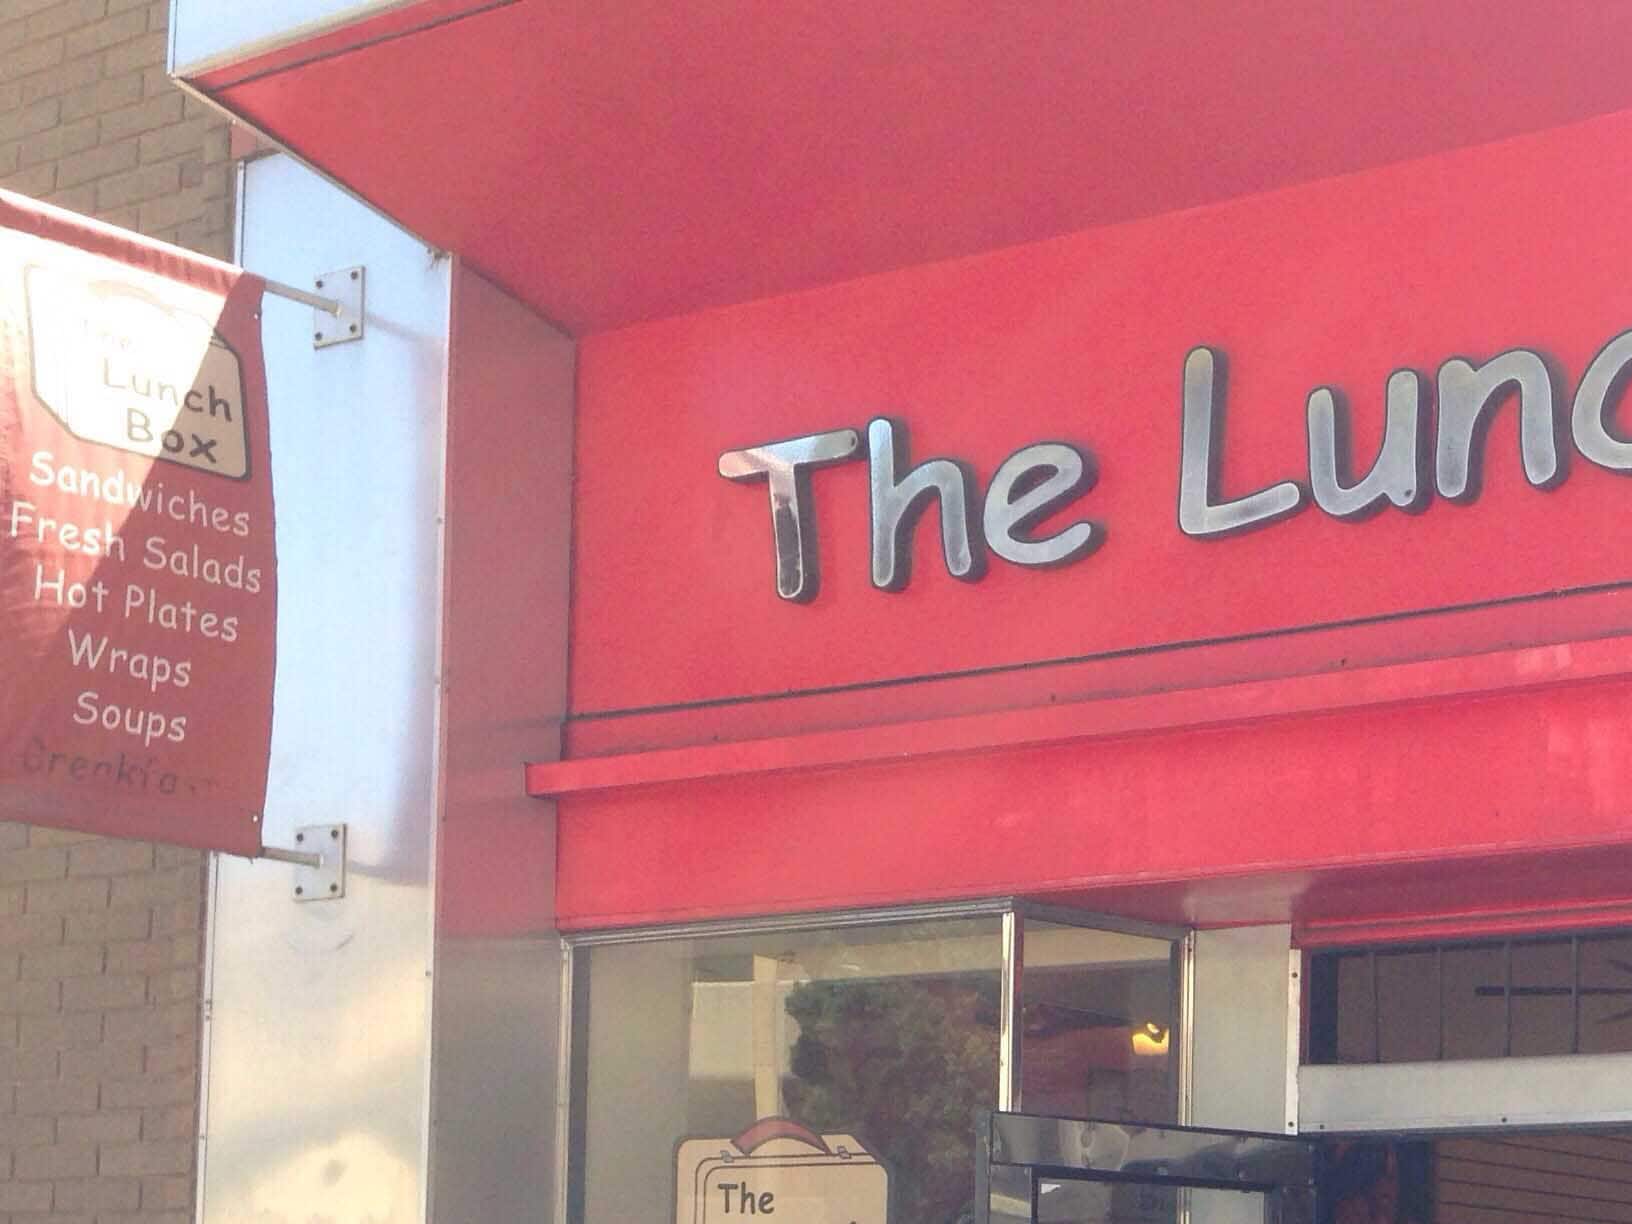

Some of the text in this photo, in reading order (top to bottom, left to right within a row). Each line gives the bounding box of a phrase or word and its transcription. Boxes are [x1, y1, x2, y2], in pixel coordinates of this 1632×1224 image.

[102, 355, 232, 422] Lunch
[126, 407, 217, 463] Box
[30, 451, 250, 537] Sandwiches
[718, 416, 1099, 604] The
[10, 501, 262, 593] Fresh Salads
[35, 564, 239, 642] Hot Plates
[68, 628, 192, 692] Wraps
[72, 691, 187, 747] Soups
[718, 1183, 774, 1215] The
